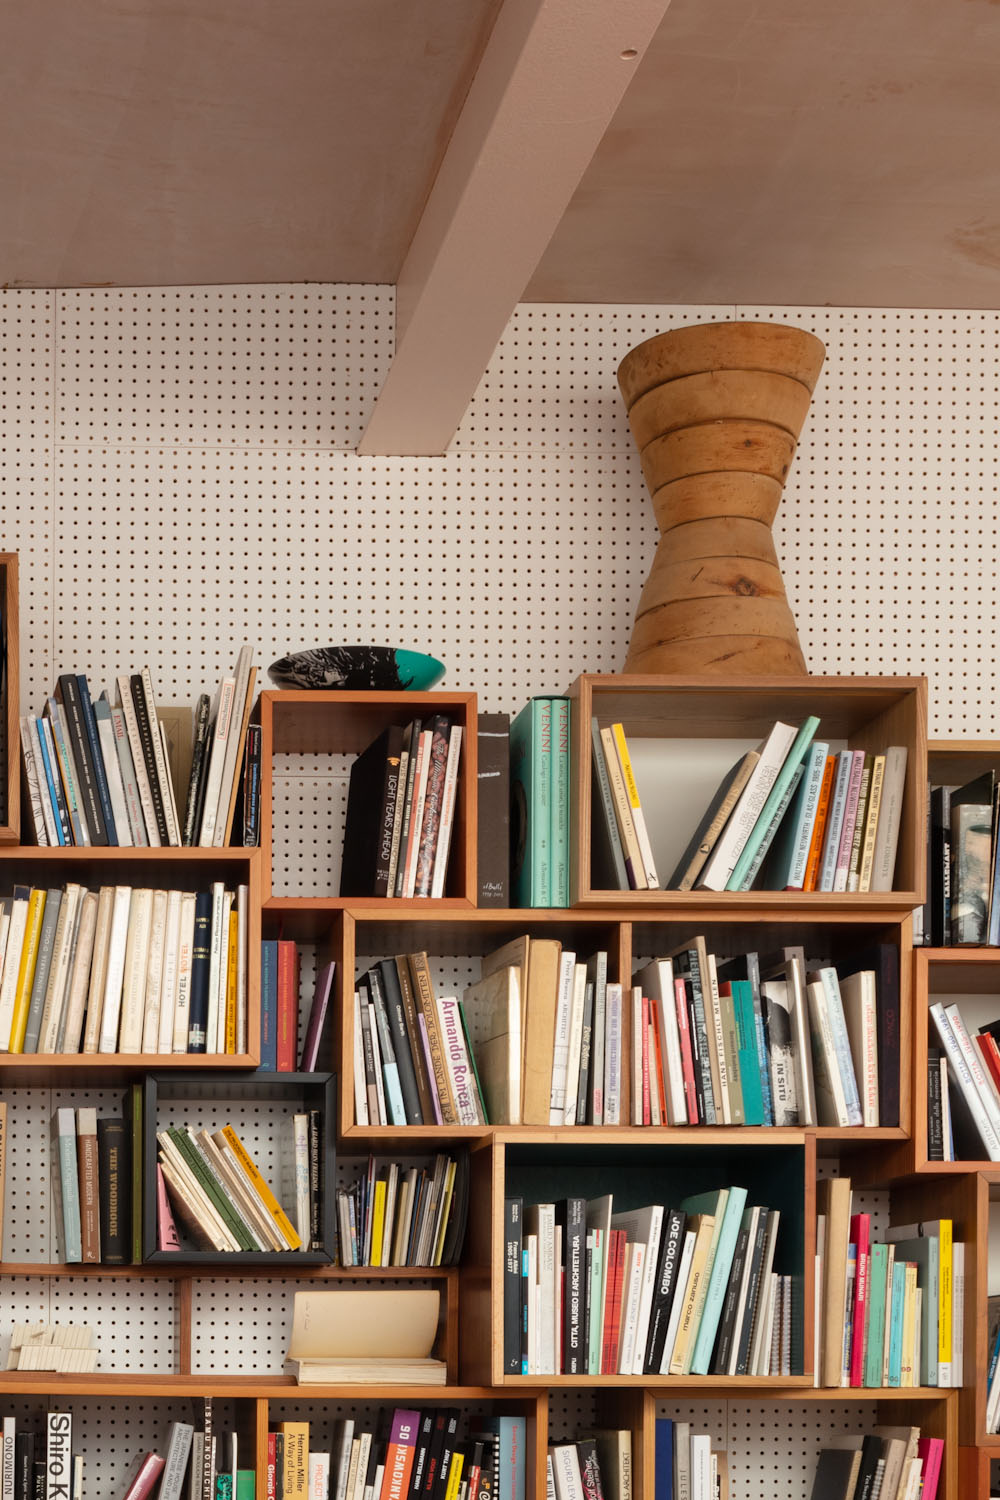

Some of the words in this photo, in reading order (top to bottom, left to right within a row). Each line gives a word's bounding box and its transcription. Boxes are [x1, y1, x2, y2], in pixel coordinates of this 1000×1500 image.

[542, 704, 552, 754] VENINI
[560, 704, 568, 754] VENINI
[387, 775, 398, 800] LIGHT
[805, 784, 818, 818] GLAS/GLASS
[385, 802, 396, 828] YEARS
[381, 829, 392, 860] AHEAD
[798, 822, 810, 852] NEUWIRTH
[793, 852, 804, 882] WALTRAUD
[441, 1000, 462, 1062] Armando
[453, 1065, 472, 1108] Ronca
[776, 1063, 786, 1076] IN
[778, 1078, 788, 1102] SITU
[85, 1139, 94, 1180] HANDCRAFTED
[86, 1181, 94, 1206] MODERN
[669, 1216, 682, 1240] JOE
[660, 1240, 676, 1296] COLOMBO
[682, 1304, 694, 1332] marco
[688, 1272, 700, 1302] zanuso
[857, 1277, 866, 1302] MUNARI
[182, 1429, 190, 1442] THE
[204, 1406, 212, 1442] ISAMU
[399, 1424, 412, 1440] 06
[49, 1415, 70, 1476] Shiro
[168, 1428, 184, 1472] ARCHITECTURE
[176, 1442, 188, 1472] JAPANESE
[287, 1440, 296, 1460] Way
[297, 1433, 306, 1468] Herman
[4, 1436, 14, 1496] NURIMONO
[203, 1446, 212, 1498] NOGUCHI
[288, 1460, 296, 1470] of
[297, 1468, 306, 1492] Miller
[562, 1450, 574, 1482] SIGURD
[584, 1460, 594, 1488] Steiner
[622, 1452, 630, 1490] ARCHITEKT
[163, 1488, 172, 1500] LIFE
[166, 1473, 174, 1488] AND
[172, 1473, 180, 1494] HOUSE
[286, 1470, 296, 1494] Living
